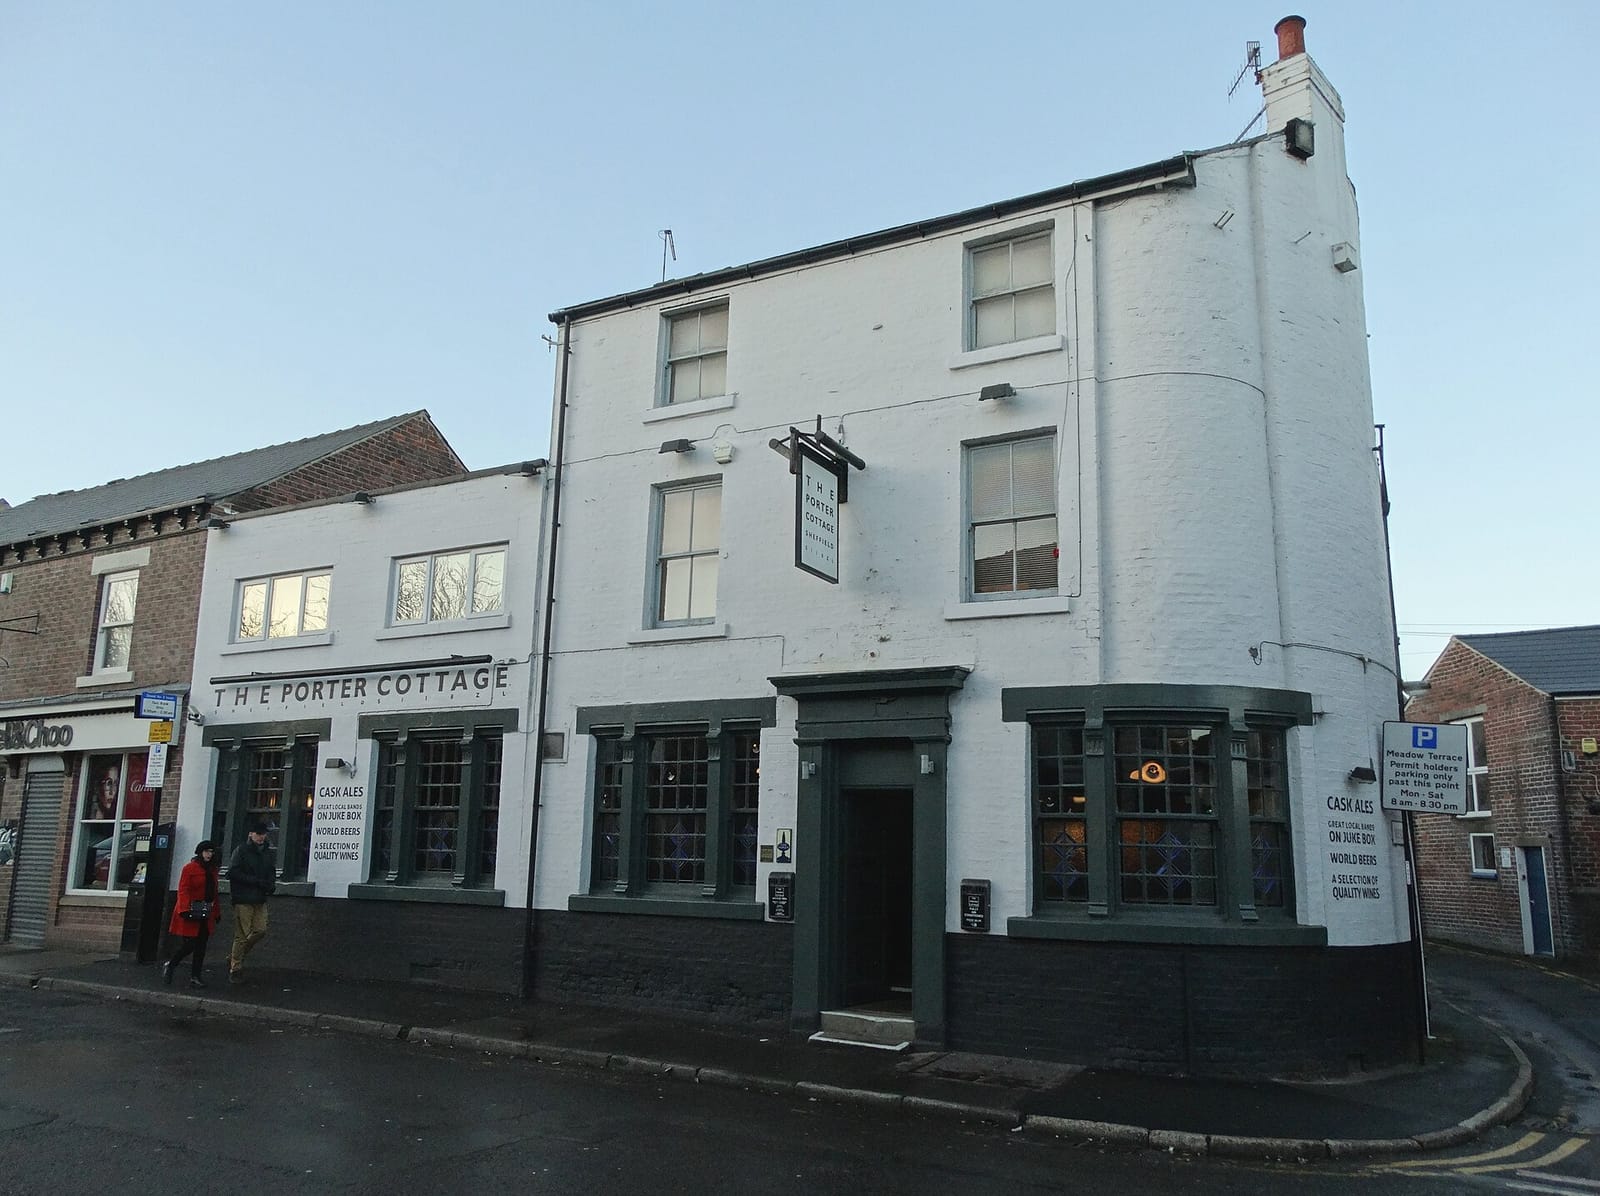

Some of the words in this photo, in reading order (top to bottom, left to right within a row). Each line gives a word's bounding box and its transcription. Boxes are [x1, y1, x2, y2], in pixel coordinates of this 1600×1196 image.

[806, 474, 834, 501] THE
[806, 493, 834, 518] PORTER
[805, 512, 834, 534] COTTAGE
[214, 685, 271, 707] THE
[281, 677, 367, 703] PORTER
[377, 667, 508, 696] COTTAGE
[1417, 727, 1434, 747] P
[1386, 749, 1424, 759] Meadow
[1428, 752, 1463, 762] Terrace
[1390, 760, 1420, 770] Permit
[1423, 763, 1458, 772] holders
[1394, 770, 1429, 780] parking
[1433, 773, 1453, 781] only
[1388, 779, 1409, 787] past
[1413, 779, 1431, 788] this
[1435, 781, 1460, 790] point
[319, 786, 342, 798] CASK
[342, 786, 364, 798] ALES
[1400, 789, 1420, 798] Mon
[1428, 791, 1444, 800] Sat
[1327, 796, 1354, 813] CASK
[1354, 799, 1374, 814] ALES
[1391, 797, 1397, 806] 8
[1443, 803, 1458, 811] pm
[317, 811, 328, 821] ON
[328, 811, 346, 821] JUKE
[346, 811, 362, 821] BOX
[1327, 820, 1345, 829] GREAT
[1345, 821, 1361, 830] LOCAL
[315, 827, 340, 836] WORLD
[340, 827, 361, 836] BEERS
[1329, 830, 1341, 843] ON
[1342, 831, 1361, 844] JUKE
[1361, 833, 1377, 846] BOX
[314, 842, 319, 850] A
[319, 842, 351, 850] SELECTION
[351, 842, 360, 850] OF
[313, 851, 339, 861] QUALITY
[339, 851, 359, 861] WINES
[1329, 852, 1358, 865] WORLD
[1358, 854, 1377, 866] BEERS
[1331, 874, 1337, 884] A
[1337, 874, 1371, 885] SELECTION
[1371, 875, 1378, 885] OF
[1332, 886, 1362, 901] QUALITY
[1362, 887, 1380, 900] WINES
